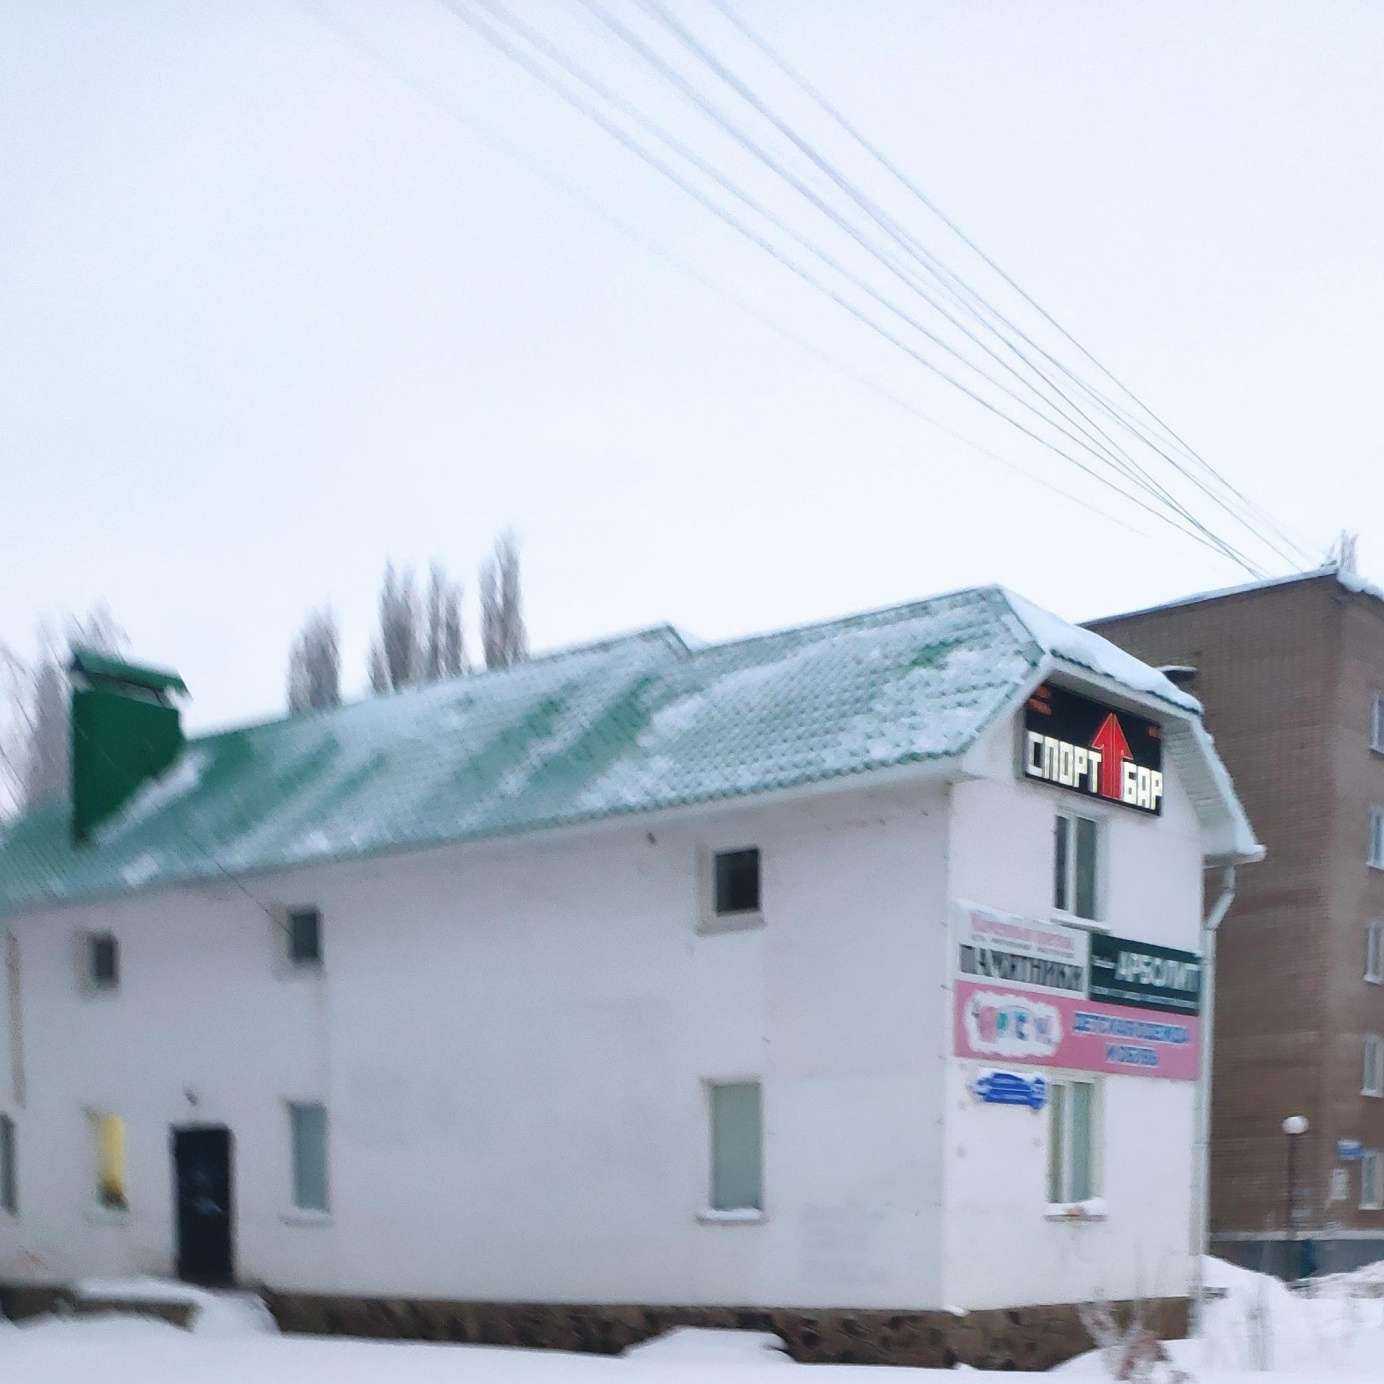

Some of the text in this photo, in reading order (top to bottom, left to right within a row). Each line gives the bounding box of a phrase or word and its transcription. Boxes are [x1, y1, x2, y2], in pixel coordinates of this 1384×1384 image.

[1027, 731, 1163, 811] СПОРТ БАР
[1114, 951, 1200, 993] АРБОЛИТ
